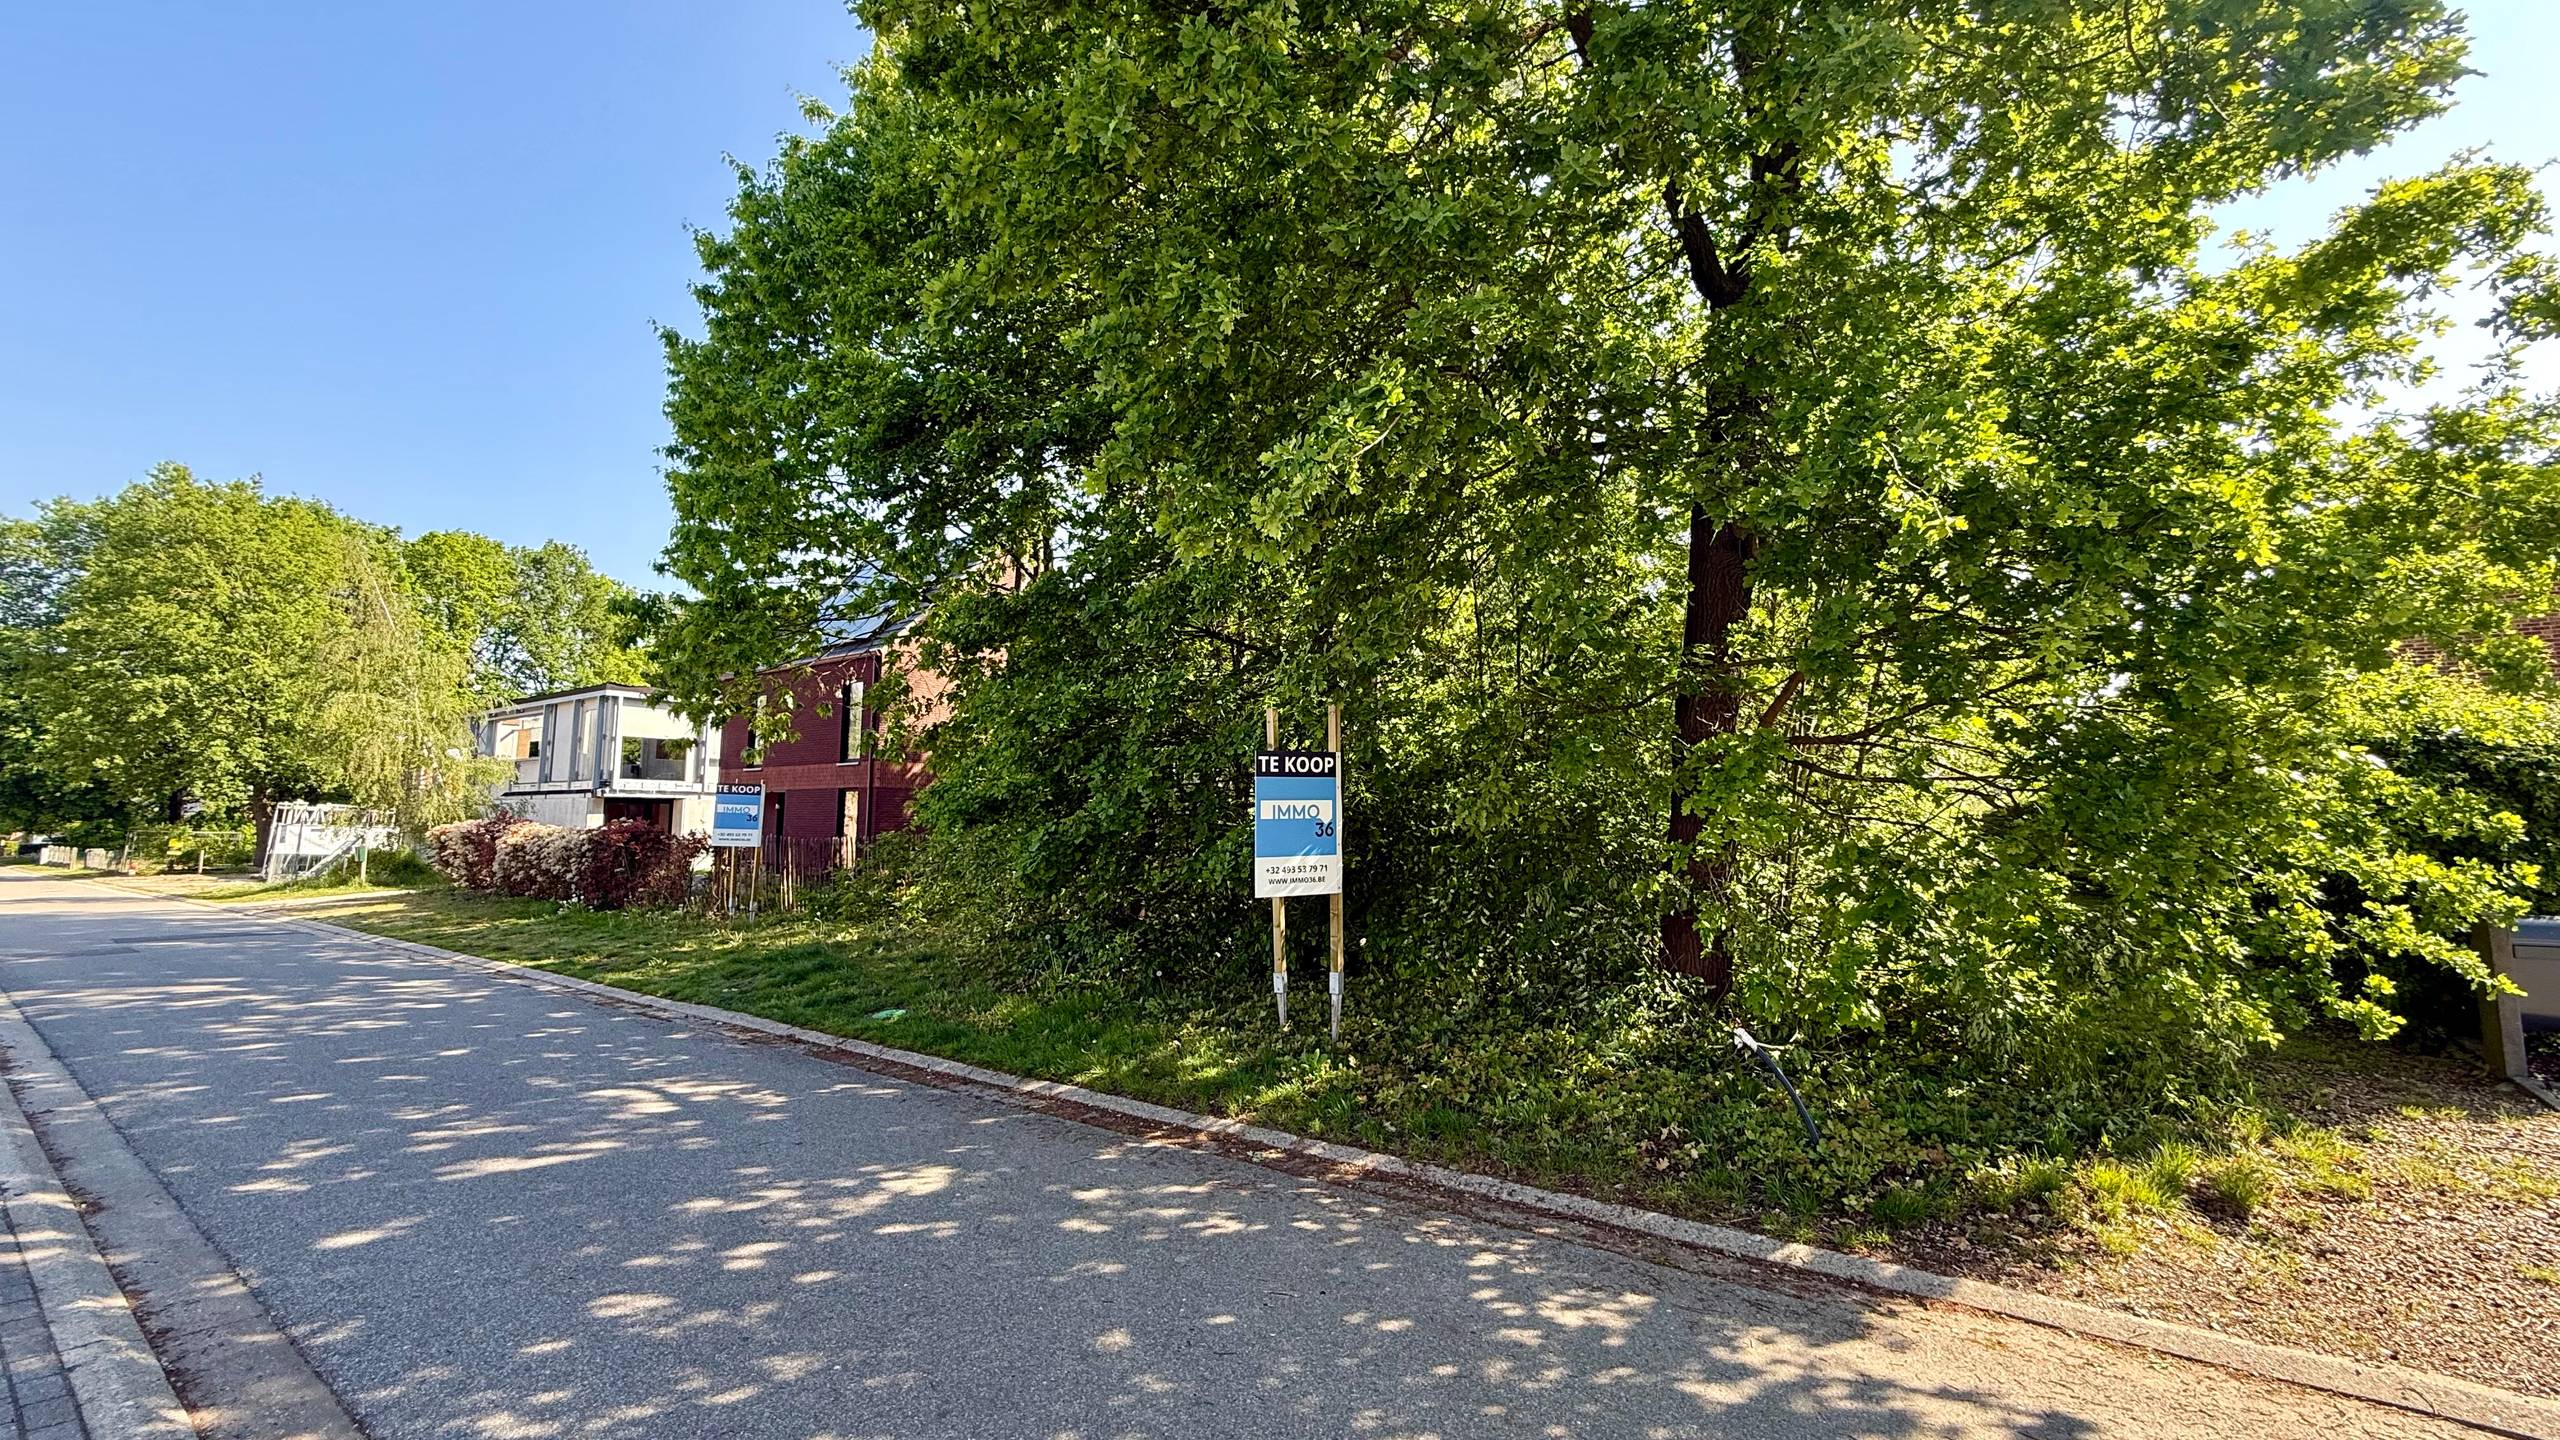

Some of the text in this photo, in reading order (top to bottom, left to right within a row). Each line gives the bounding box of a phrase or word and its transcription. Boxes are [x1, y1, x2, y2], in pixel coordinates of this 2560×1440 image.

[1258, 756, 1334, 773] TE KOOP
[718, 785, 761, 794] TE KOOP
[723, 806, 750, 814] IMMO
[1272, 804, 1320, 820] IMMO
[746, 814, 758, 822] 36
[1315, 822, 1334, 837] 36
[1266, 866, 1280, 874] +32
[1297, 865, 1307, 873] 53
[1309, 864, 1318, 872] 79
[1319, 864, 1328, 872] 71
